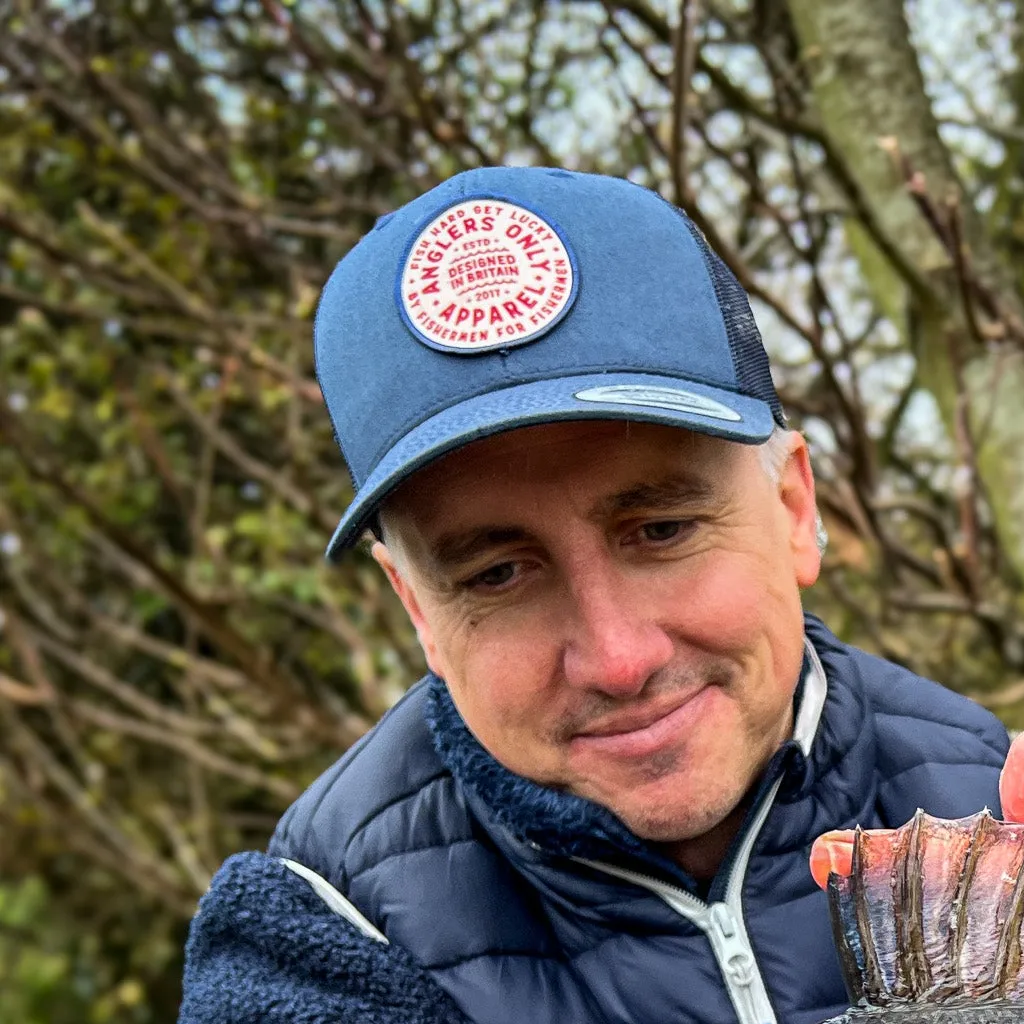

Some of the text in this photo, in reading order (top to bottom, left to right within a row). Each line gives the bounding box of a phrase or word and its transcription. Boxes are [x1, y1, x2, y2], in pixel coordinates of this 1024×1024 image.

[411, 206, 553, 270] FISH HARD GET LUCKY
[462, 238, 490, 250] ESTD
[421, 217, 551, 295] ANGLERS ONLY
[448, 255, 516, 278] DESIGNED
[450, 266, 519, 290] IN BRITAIN
[408, 260, 568, 342] BY FISHERMEN FOR FISHERMEN
[439, 285, 546, 327] APPAREL
[475, 289, 501, 301] 2017
